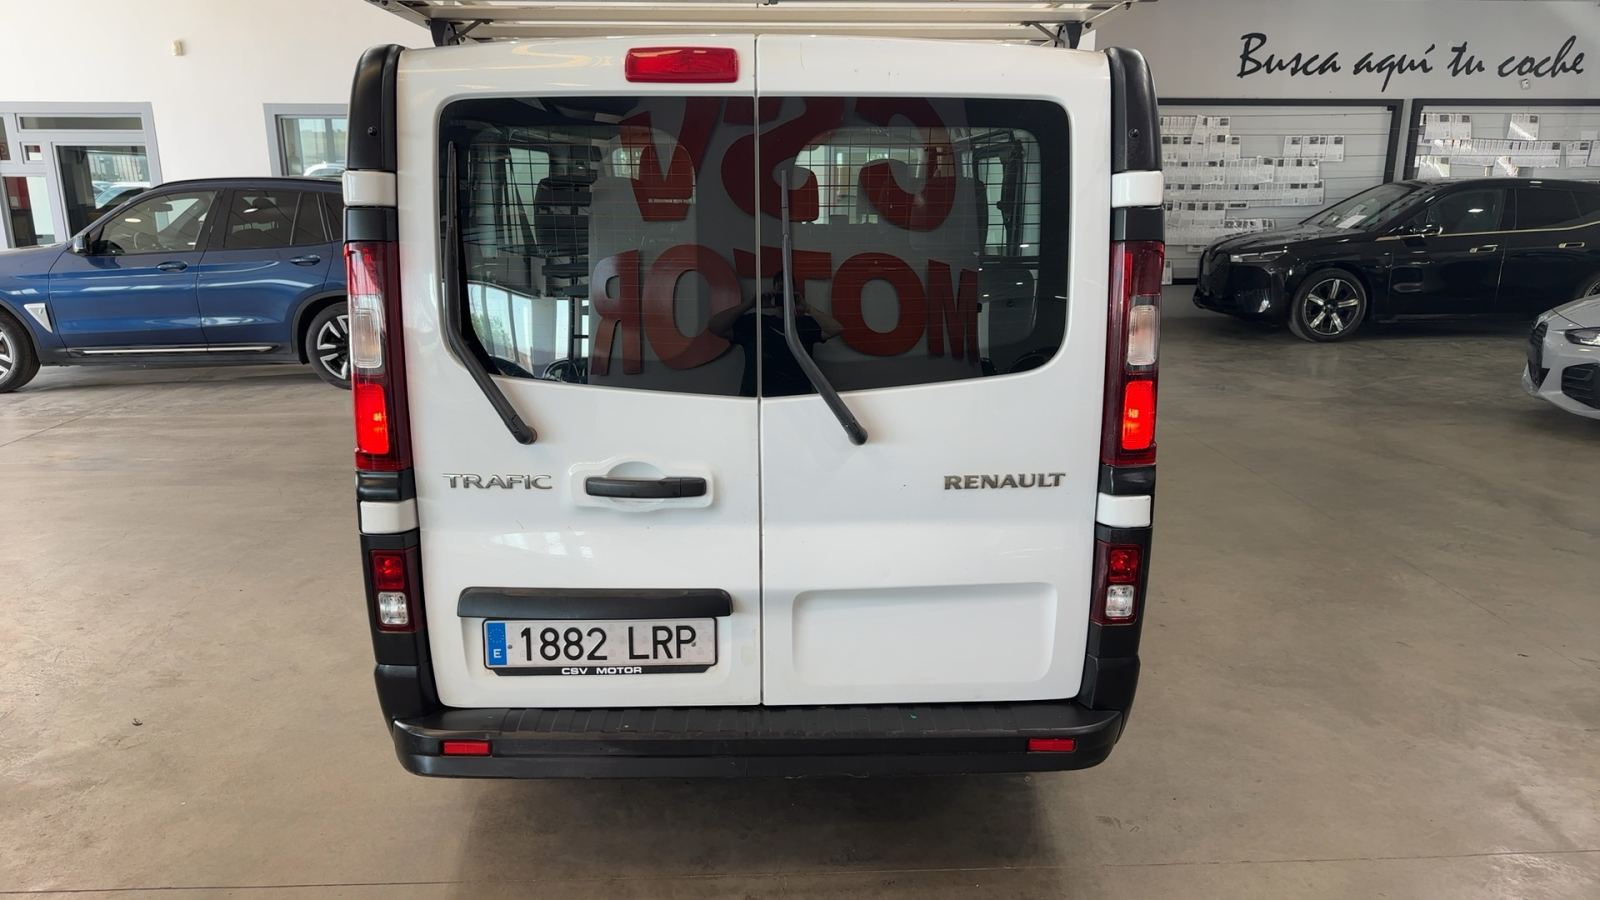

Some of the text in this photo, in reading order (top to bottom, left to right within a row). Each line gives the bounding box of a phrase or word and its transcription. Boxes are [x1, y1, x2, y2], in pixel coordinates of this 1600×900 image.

[1237, 32, 1585, 92] Busca aquí tu coche
[442, 473, 553, 490] TRAFIC
[944, 473, 1066, 490] RENAULT
[520, 625, 697, 661] 1882 LRP
[493, 648, 502, 658] E
[561, 666, 642, 675] CSV MOTOR
